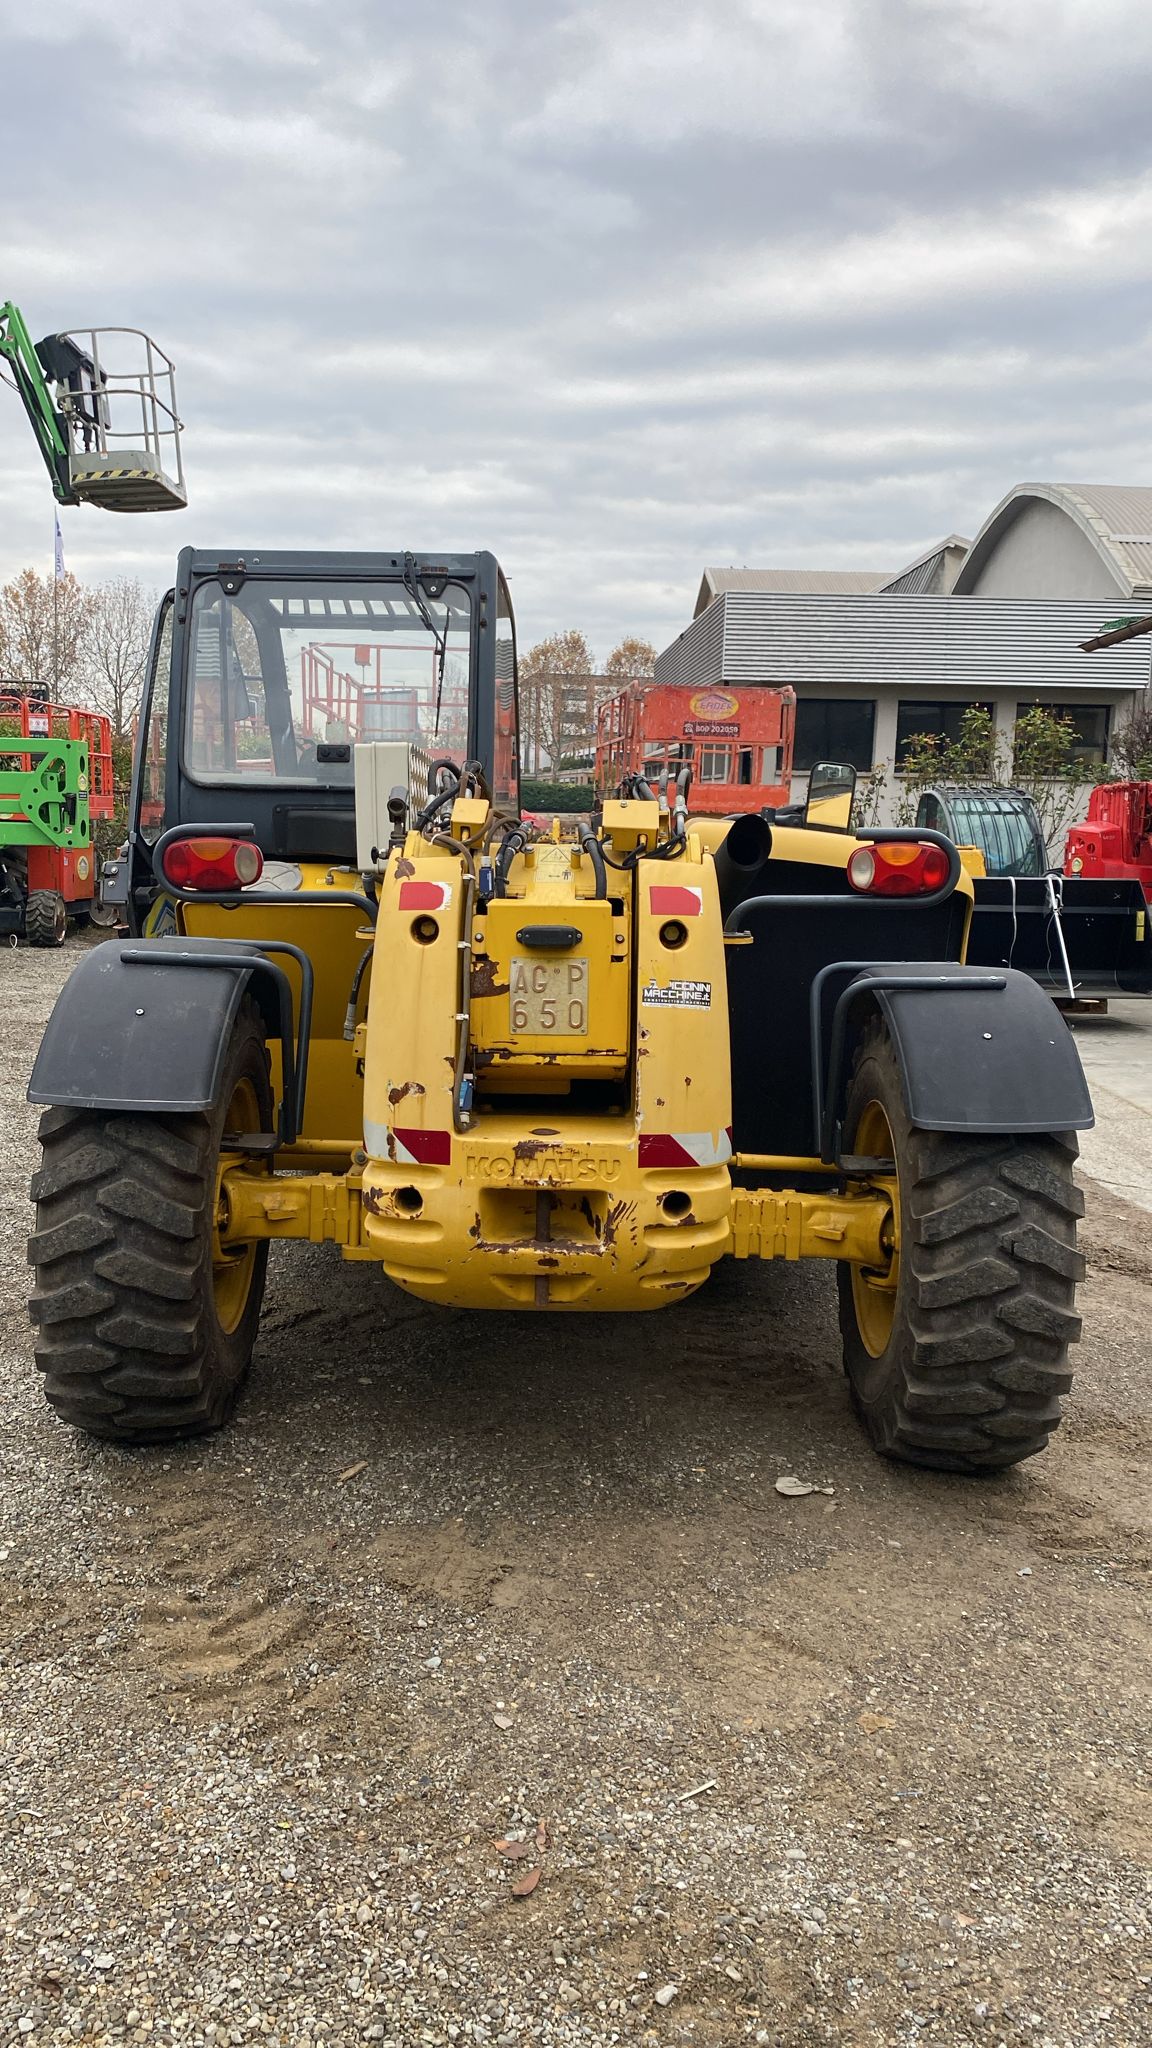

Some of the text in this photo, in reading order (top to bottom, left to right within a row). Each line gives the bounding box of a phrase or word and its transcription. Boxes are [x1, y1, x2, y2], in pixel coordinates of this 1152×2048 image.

[514, 964, 584, 994] AG P
[644, 989, 710, 1001] MACCHINE.it
[512, 998, 584, 1030] 650
[466, 1155, 621, 1183] KOMATSU
